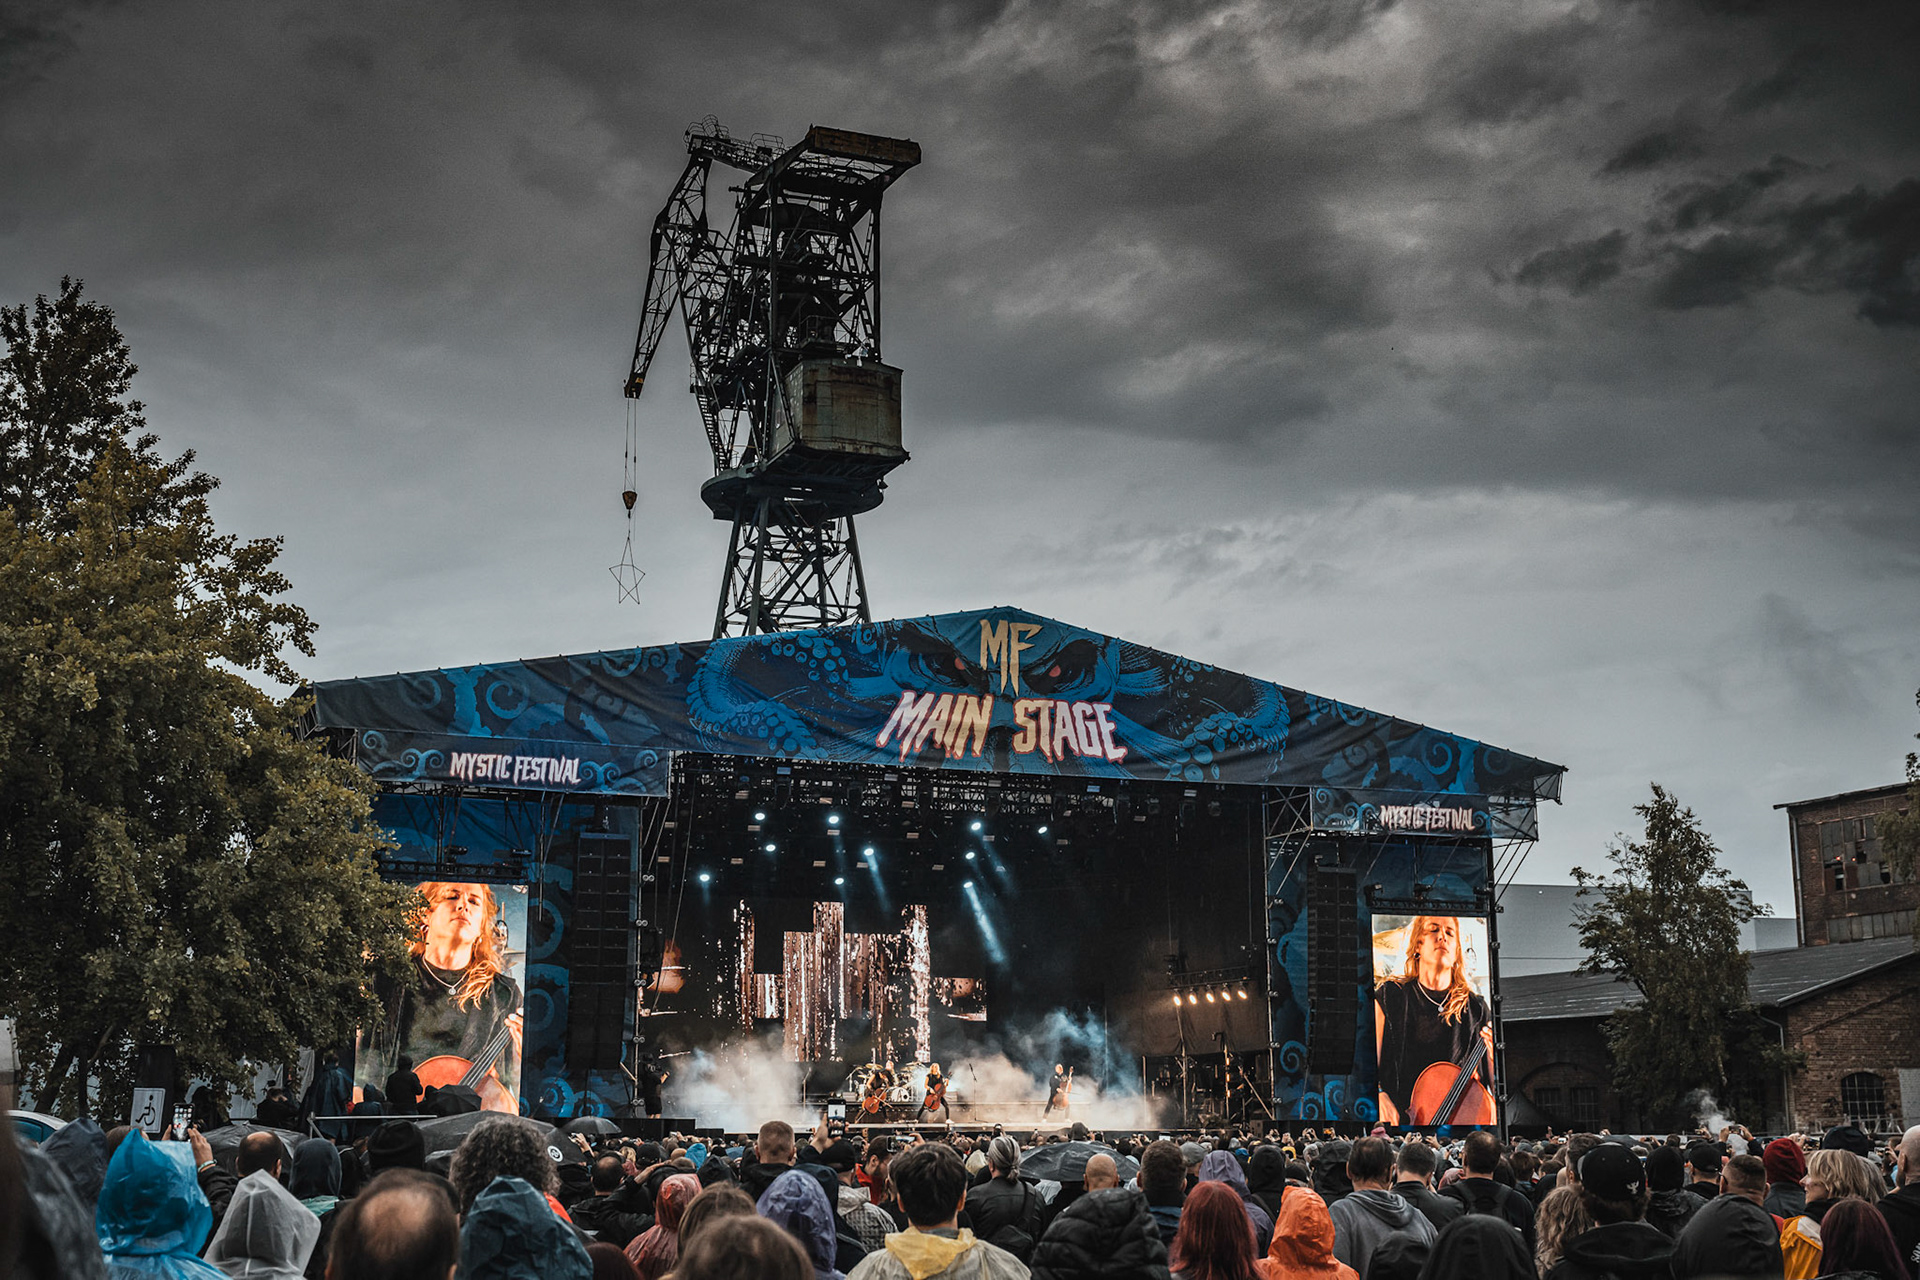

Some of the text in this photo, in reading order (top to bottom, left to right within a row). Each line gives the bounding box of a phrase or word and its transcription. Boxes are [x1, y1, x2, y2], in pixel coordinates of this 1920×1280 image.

[979, 618, 1043, 697] MF
[876, 690, 1128, 763] MAIN STAGE
[450, 752, 581, 786] MYSTIC FESTIVAL
[1379, 805, 1476, 833] MYSTIC FESTIVAL
